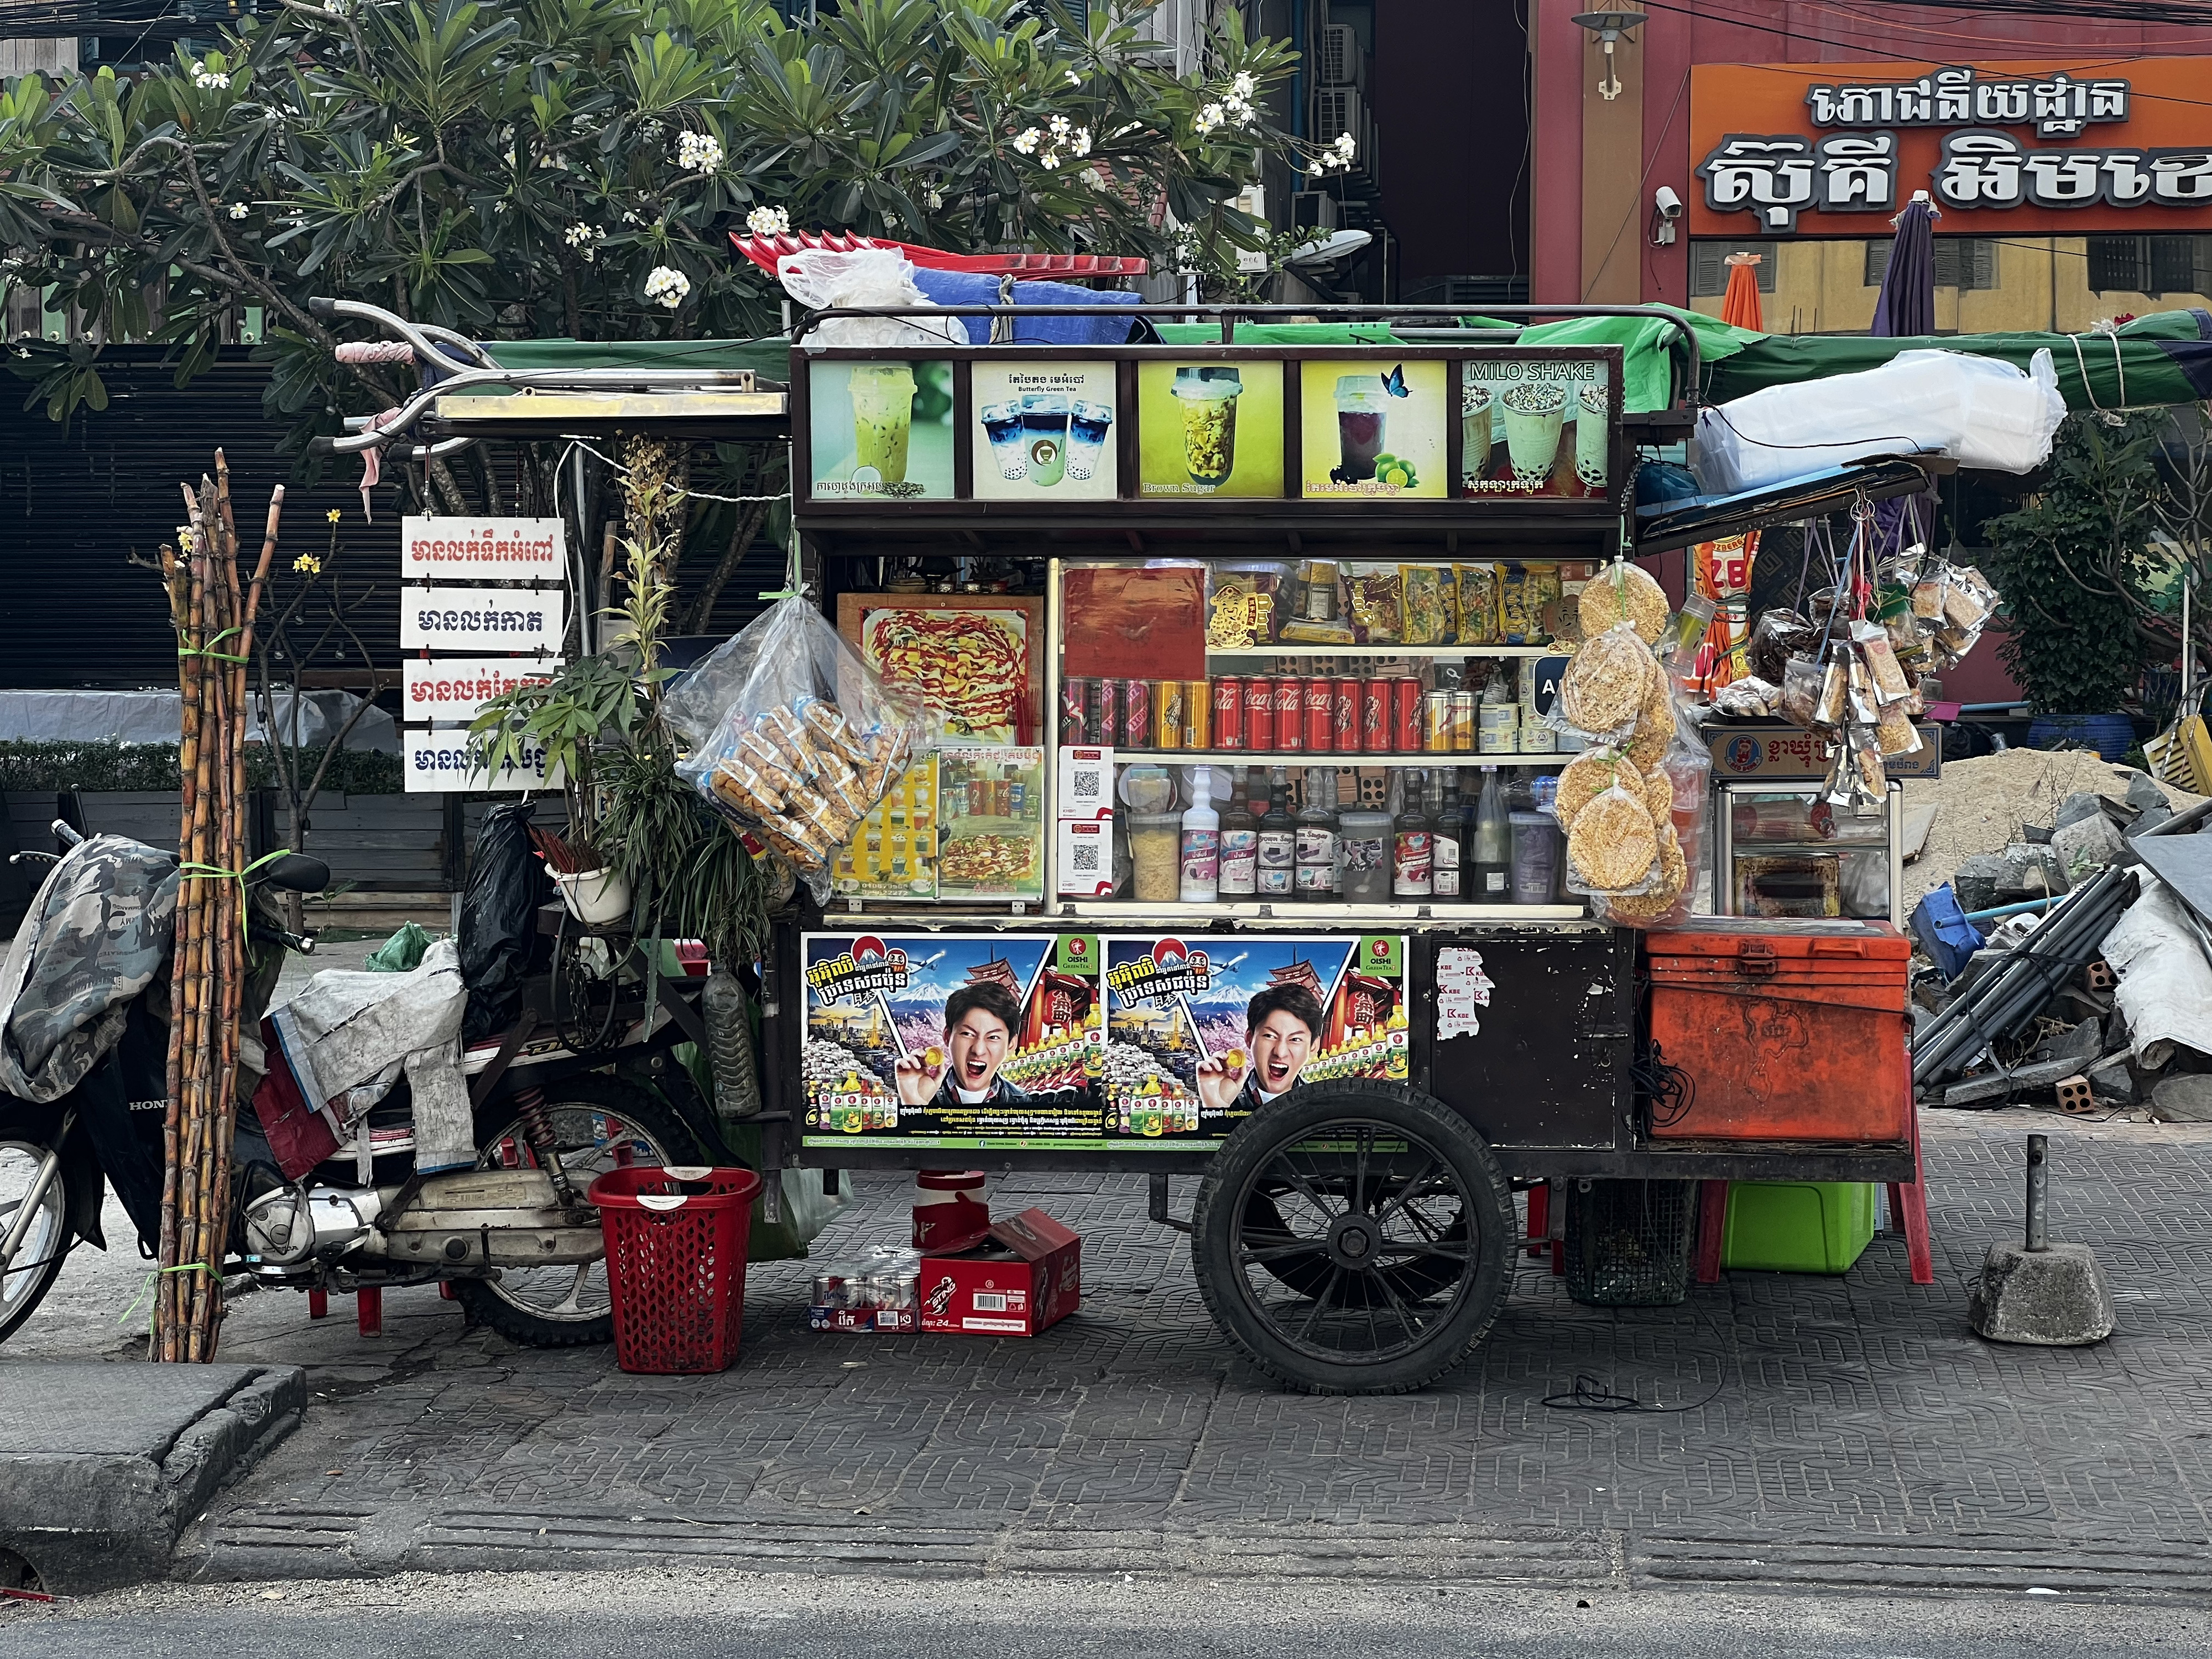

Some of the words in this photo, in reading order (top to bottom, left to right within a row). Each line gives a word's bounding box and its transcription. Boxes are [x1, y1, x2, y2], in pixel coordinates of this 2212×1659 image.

[1470, 363, 1523, 381] MILO
[1527, 363, 1595, 381] SHAKE
[1142, 483, 1179, 494] Brown
[1181, 483, 1215, 497] Sugar
[411, 529, 553, 562] មានលក់ទឹកអំពៅ
[418, 599, 543, 632] មានលក់កាត
[1280, 835, 1295, 844] Suga
[854, 990, 873, 1004] 日本
[1155, 993, 1174, 1006] 日本
[129, 1099, 168, 1110] HON
[932, 1282, 957, 1308] STING
